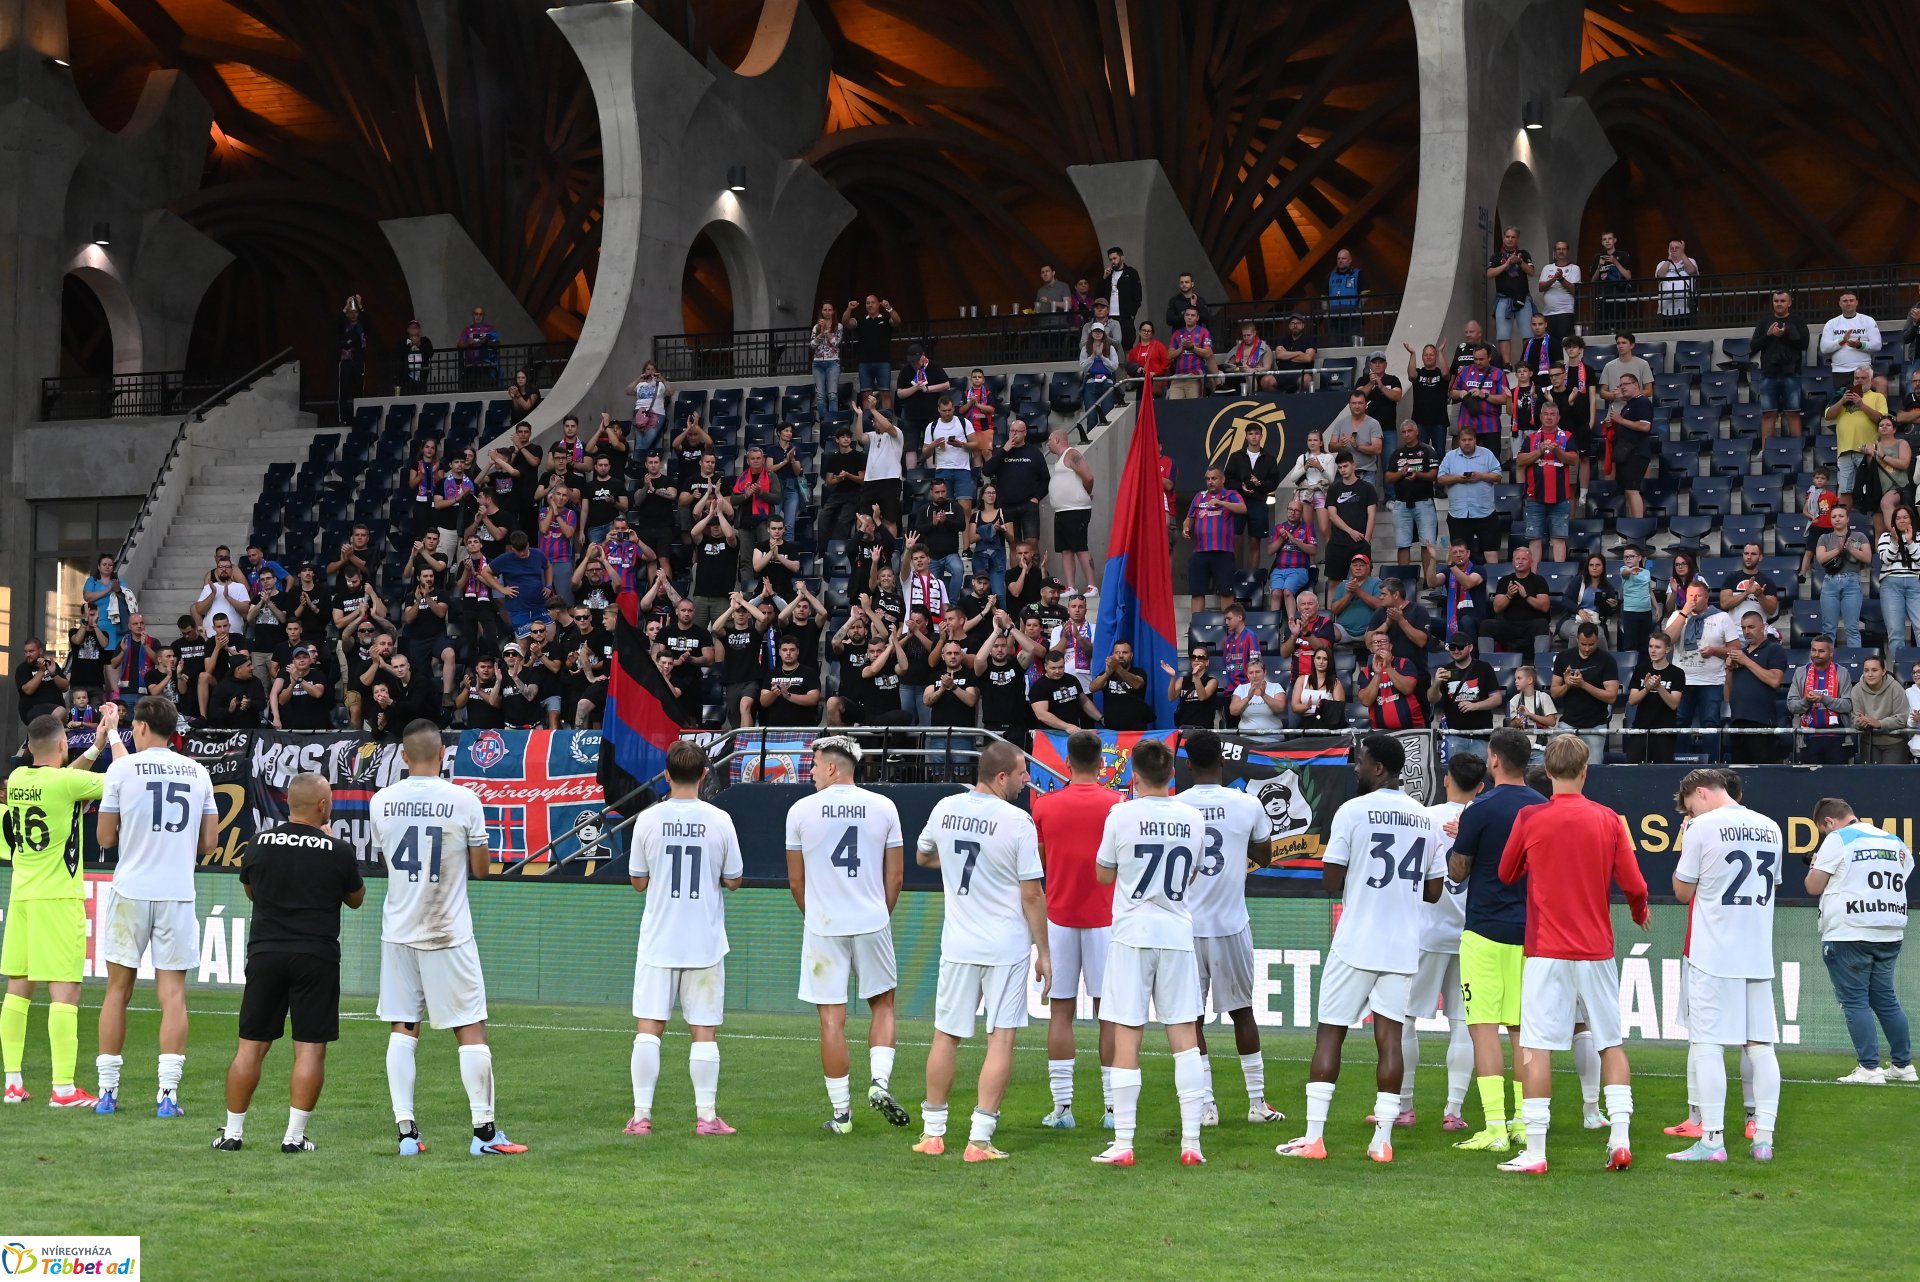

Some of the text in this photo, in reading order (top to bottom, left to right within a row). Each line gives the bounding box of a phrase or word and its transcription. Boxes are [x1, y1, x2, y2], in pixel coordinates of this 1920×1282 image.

[135, 762, 198, 778] TEMESVÁRI
[1403, 736, 1424, 802] NYSFC
[9, 785, 42, 801] KERSÁK
[146, 781, 191, 833] 15
[383, 802, 454, 819] EVANGELOU
[822, 804, 866, 819] ALAXAI
[662, 818, 706, 838] MÁJER
[942, 814, 998, 837] ANTONOV
[1139, 820, 1192, 839] KATONA
[1368, 810, 1431, 831] EDOMWONYI
[257, 832, 333, 851] macron
[1719, 823, 1779, 845] KOVÁCSRÉTI
[391, 825, 443, 883] 41
[831, 825, 861, 878] 4
[1366, 832, 1427, 892] 34
[665, 845, 702, 899] 11
[954, 840, 981, 896] 7
[1131, 844, 1193, 902] 70
[1721, 850, 1777, 906] 23
[1867, 870, 1904, 892] 076
[1846, 899, 1908, 916] Klubméd
